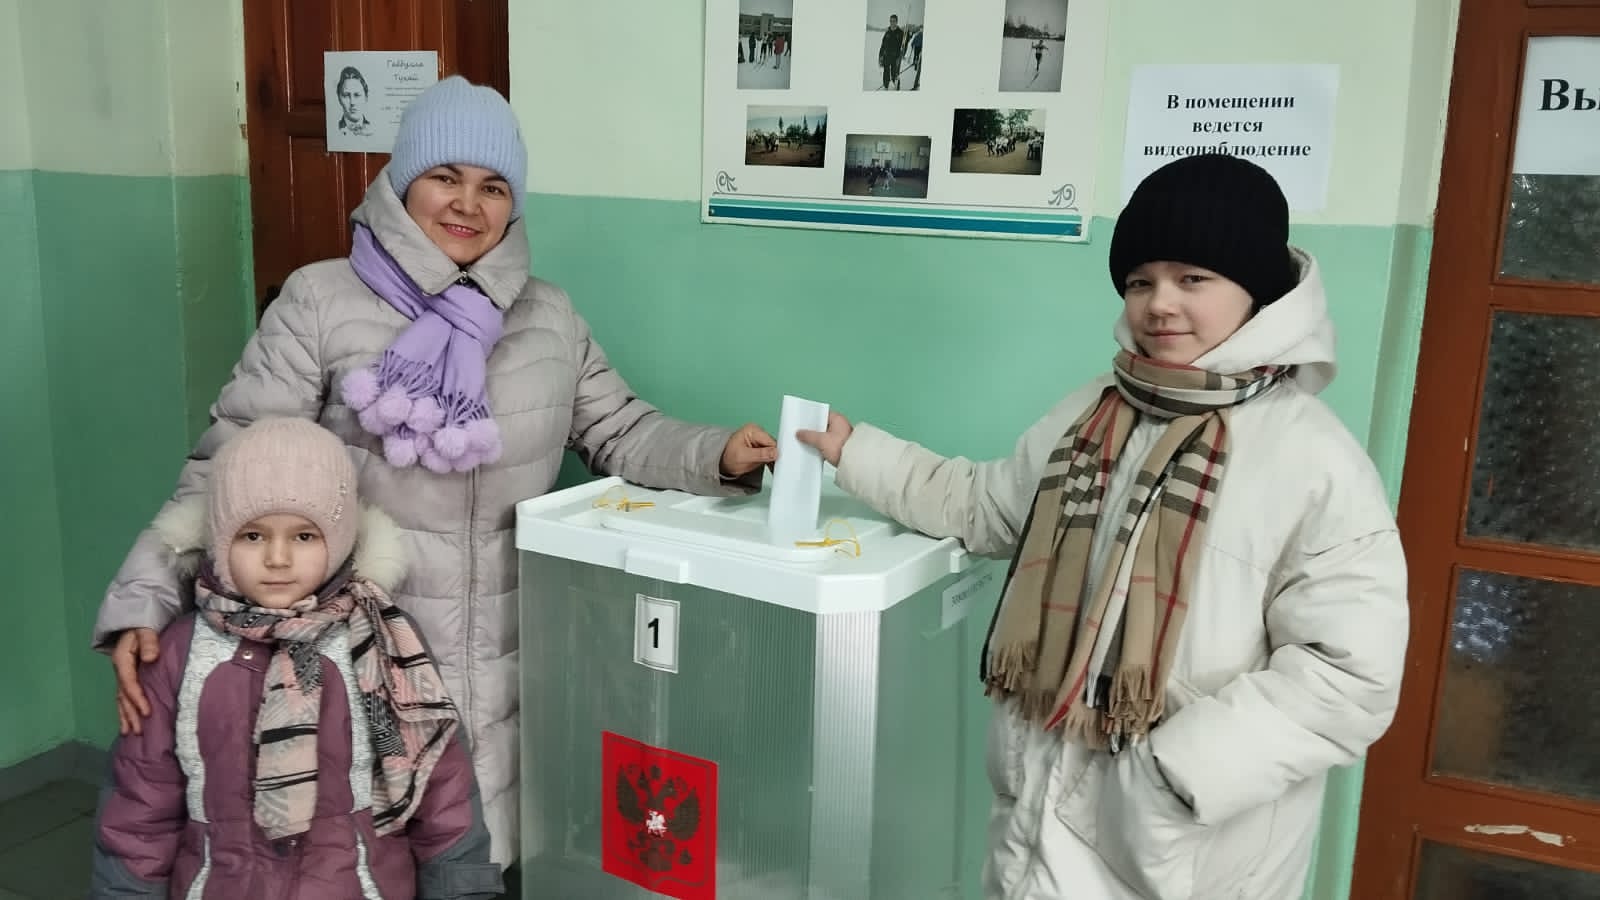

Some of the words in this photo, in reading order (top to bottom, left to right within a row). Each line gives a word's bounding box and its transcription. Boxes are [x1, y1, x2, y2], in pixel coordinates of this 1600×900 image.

[1167, 94, 1179, 109] В
[1185, 96, 1295, 110] помещении
[1192, 120, 1264, 133] ведется
[1143, 141, 1311, 157] видеонаблюдение
[648, 618, 659, 649] 1
